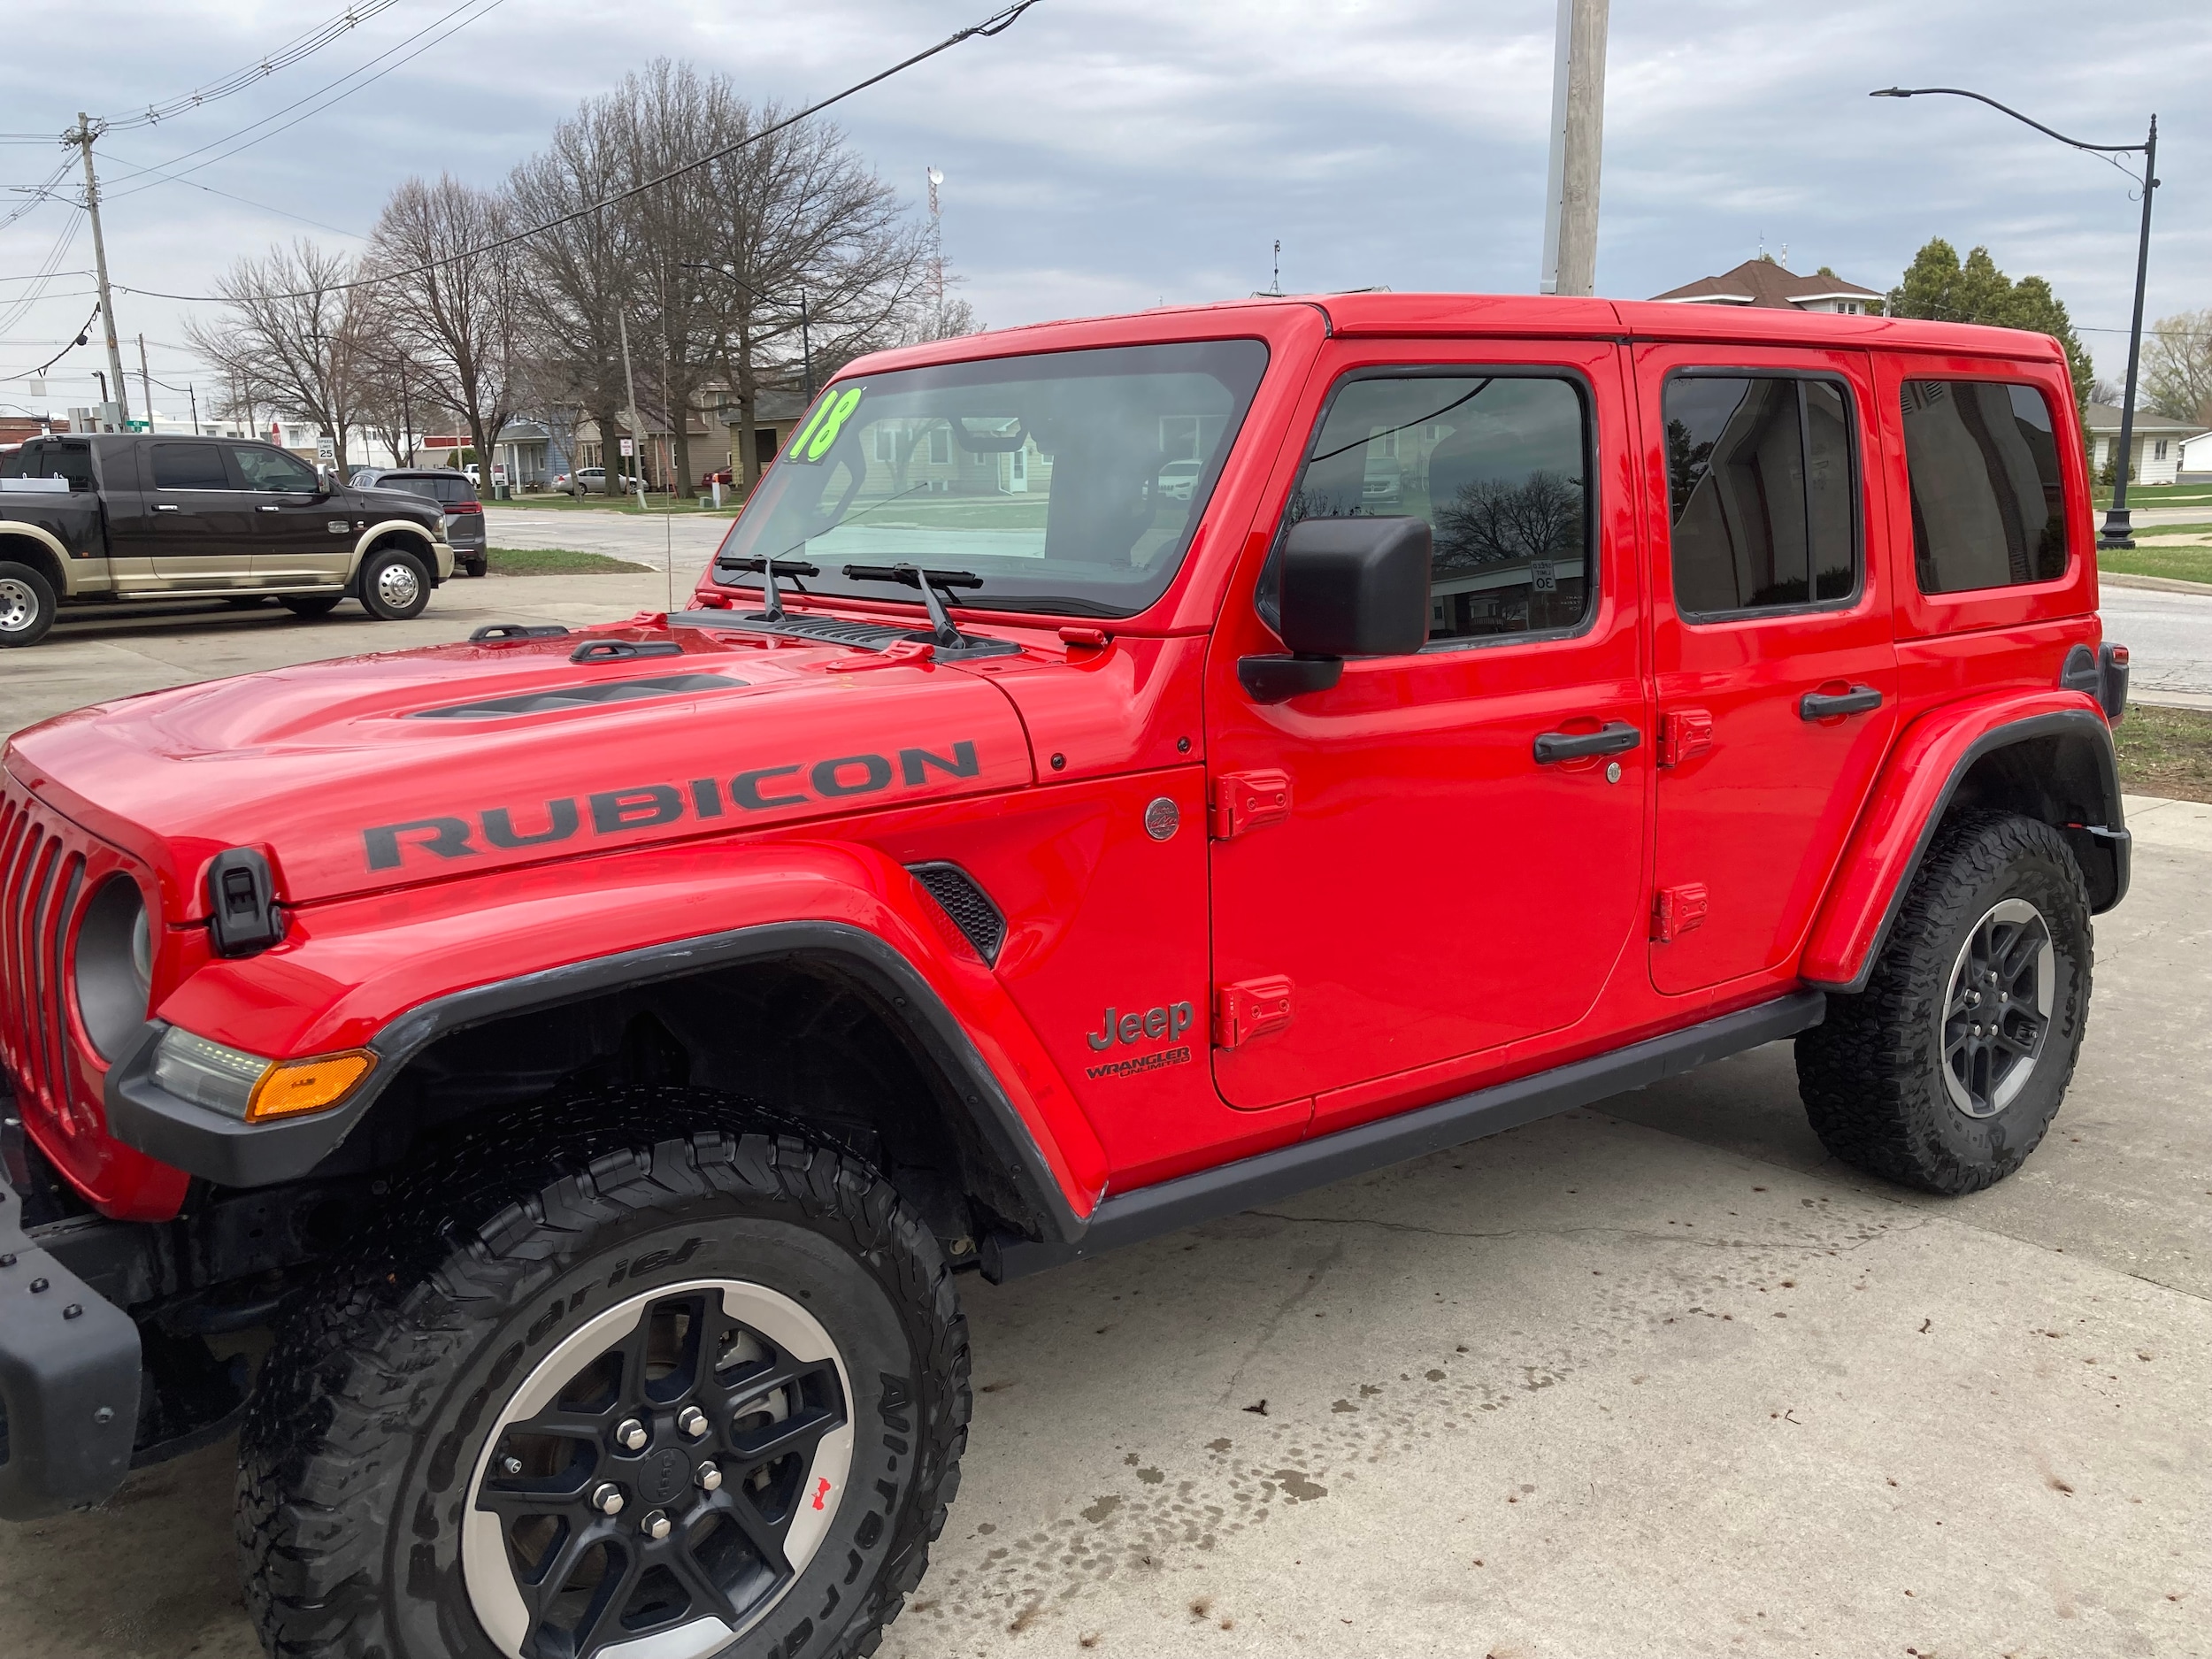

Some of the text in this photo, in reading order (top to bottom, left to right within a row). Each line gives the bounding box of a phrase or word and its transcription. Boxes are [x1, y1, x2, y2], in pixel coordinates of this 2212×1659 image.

[788, 388, 863, 462] 18
[363, 740, 980, 873] RUBICON
[1087, 1001, 1194, 1051] Jeep
[1087, 1047, 1191, 1079] WRANGLER
[1119, 1056, 1191, 1078] UNLIMITED
